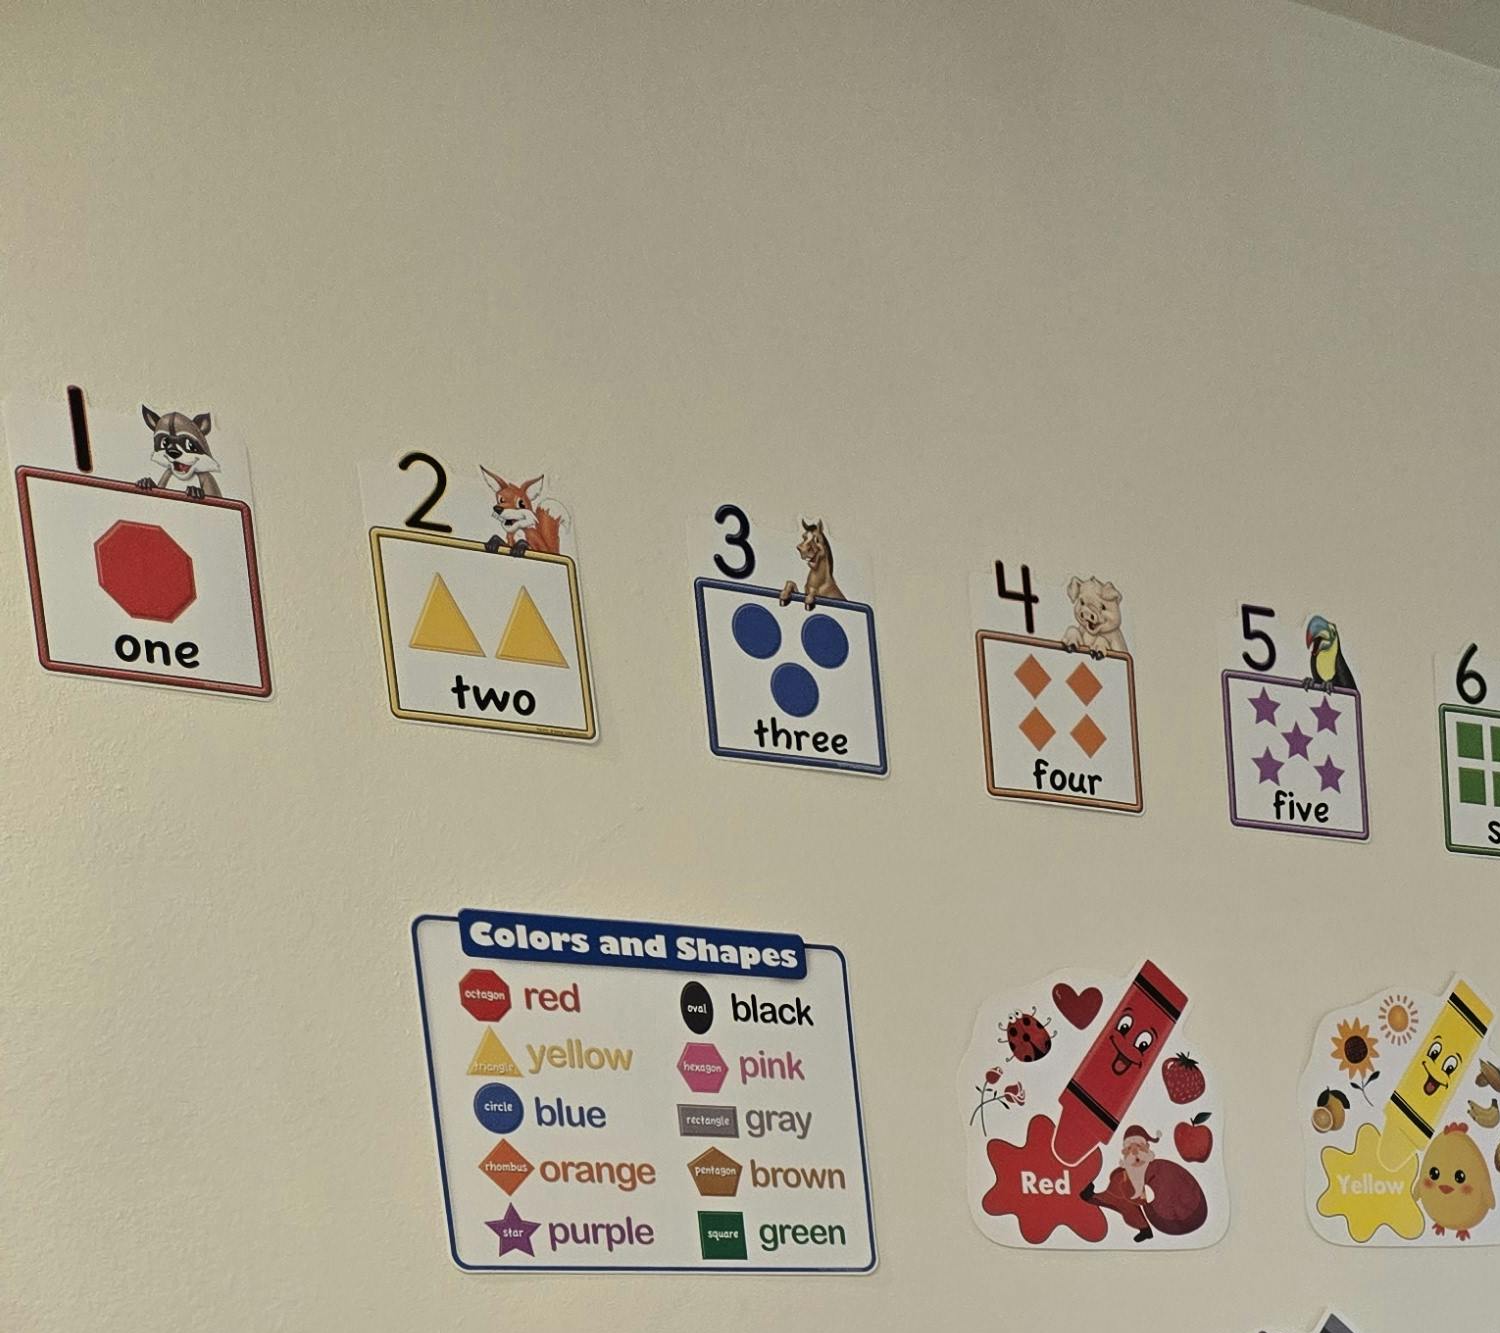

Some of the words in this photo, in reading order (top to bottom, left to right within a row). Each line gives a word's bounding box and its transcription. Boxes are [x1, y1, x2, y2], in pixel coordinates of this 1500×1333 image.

[67, 385, 93, 473] 1
[398, 452, 453, 534] 2
[714, 504, 756, 580] 3
[994, 560, 1040, 634] 4
[114, 633, 201, 670] one
[1242, 604, 1276, 671] 5
[1455, 643, 1487, 705] 6
[451, 675, 536, 718] two
[753, 716, 849, 756] three
[1033, 759, 1103, 796] four
[1273, 790, 1330, 824] five
[468, 922, 590, 954] Colors
[600, 931, 668, 960] and
[676, 936, 799, 970] Shapes
[465, 988, 506, 1002] octagon
[523, 982, 581, 1013] red
[687, 1004, 707, 1014] oval
[731, 992, 815, 1026] black
[526, 1038, 634, 1074] yellow
[683, 1061, 722, 1074] hexagon
[739, 1050, 806, 1085] pink
[484, 1100, 513, 1113] circle
[534, 1096, 607, 1128] blue
[686, 1114, 730, 1127] rectangle
[745, 1109, 813, 1140] gray
[484, 1161, 528, 1173] rhombus
[539, 1160, 657, 1192] orange
[694, 1166, 737, 1177] pentagon
[750, 1158, 846, 1190] brown
[1020, 1170, 1072, 1196] Red
[1337, 1173, 1406, 1197] Yellow
[503, 1228, 524, 1238] star
[548, 1216, 655, 1252] purple
[707, 1230, 739, 1241] square
[759, 1223, 847, 1252] green
